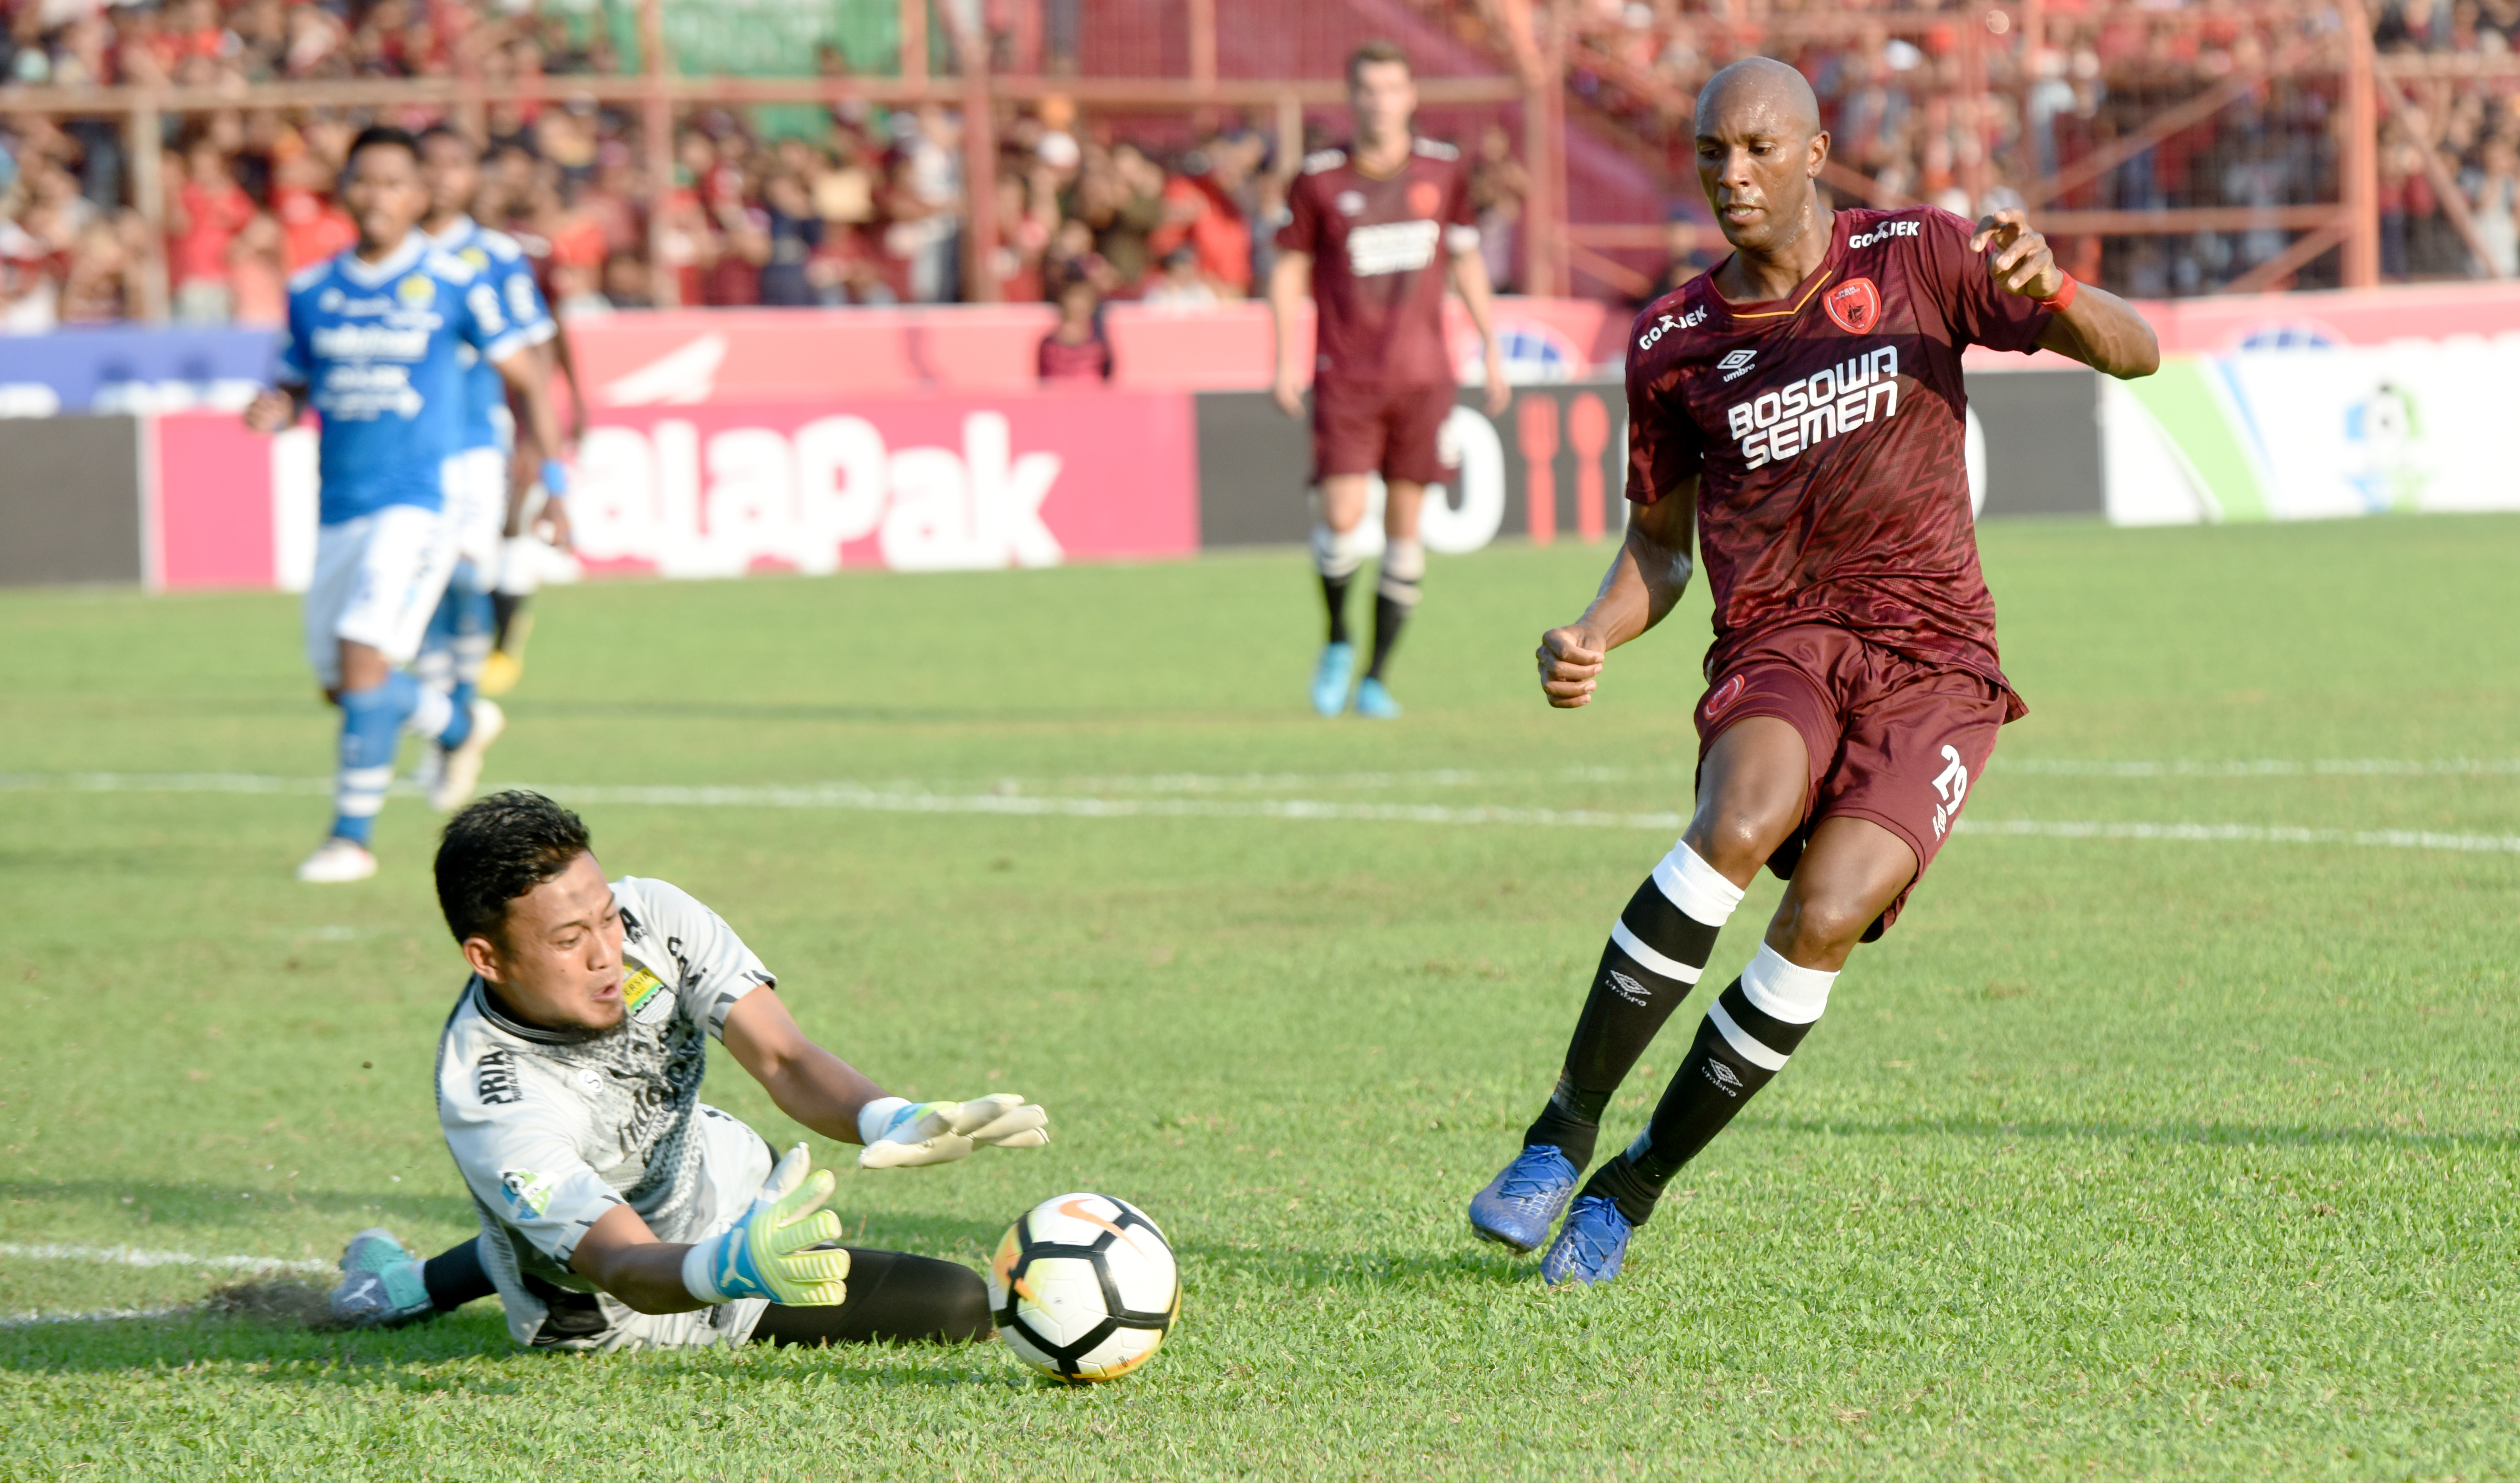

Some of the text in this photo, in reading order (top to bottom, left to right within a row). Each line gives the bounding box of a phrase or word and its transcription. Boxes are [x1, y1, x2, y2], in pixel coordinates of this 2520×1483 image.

[1723, 363, 1756, 382] umbro
[1728, 345, 1898, 440] BOSOWA
[1742, 380, 1898, 470] SEMEN
[1932, 744, 1968, 816] 29
[623, 970, 649, 996] ERSI
[1605, 979, 1647, 1007] umbro
[1701, 1066, 1737, 1097] umbro
